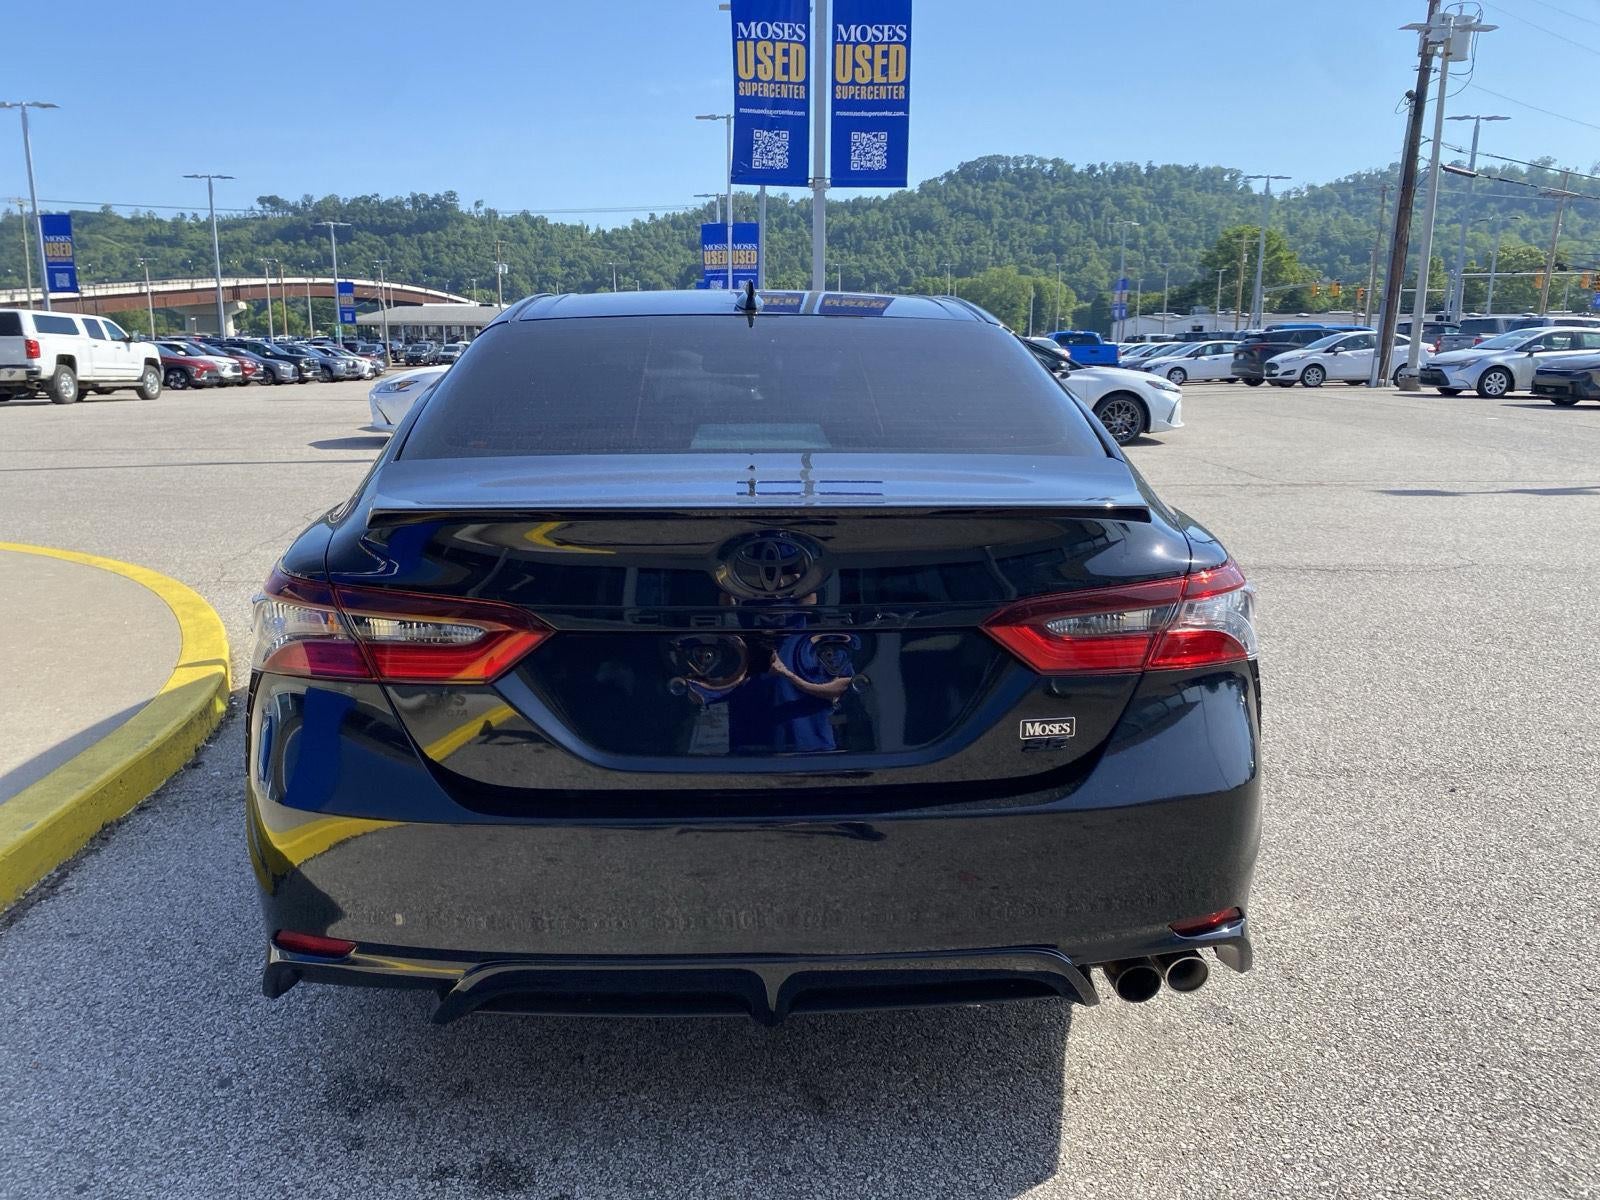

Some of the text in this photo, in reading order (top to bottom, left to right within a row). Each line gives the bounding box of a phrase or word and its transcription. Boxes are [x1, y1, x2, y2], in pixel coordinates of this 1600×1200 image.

[736, 21, 806, 42] MOSES
[836, 24, 907, 42] MOSES
[737, 40, 806, 83] USED
[835, 44, 907, 84] USED
[738, 81, 806, 99] SUPERCENTER
[835, 85, 905, 100] SUPERCENTER
[46, 242, 72, 257] USED
[704, 250, 728, 265] USED
[733, 250, 757, 265] USED
